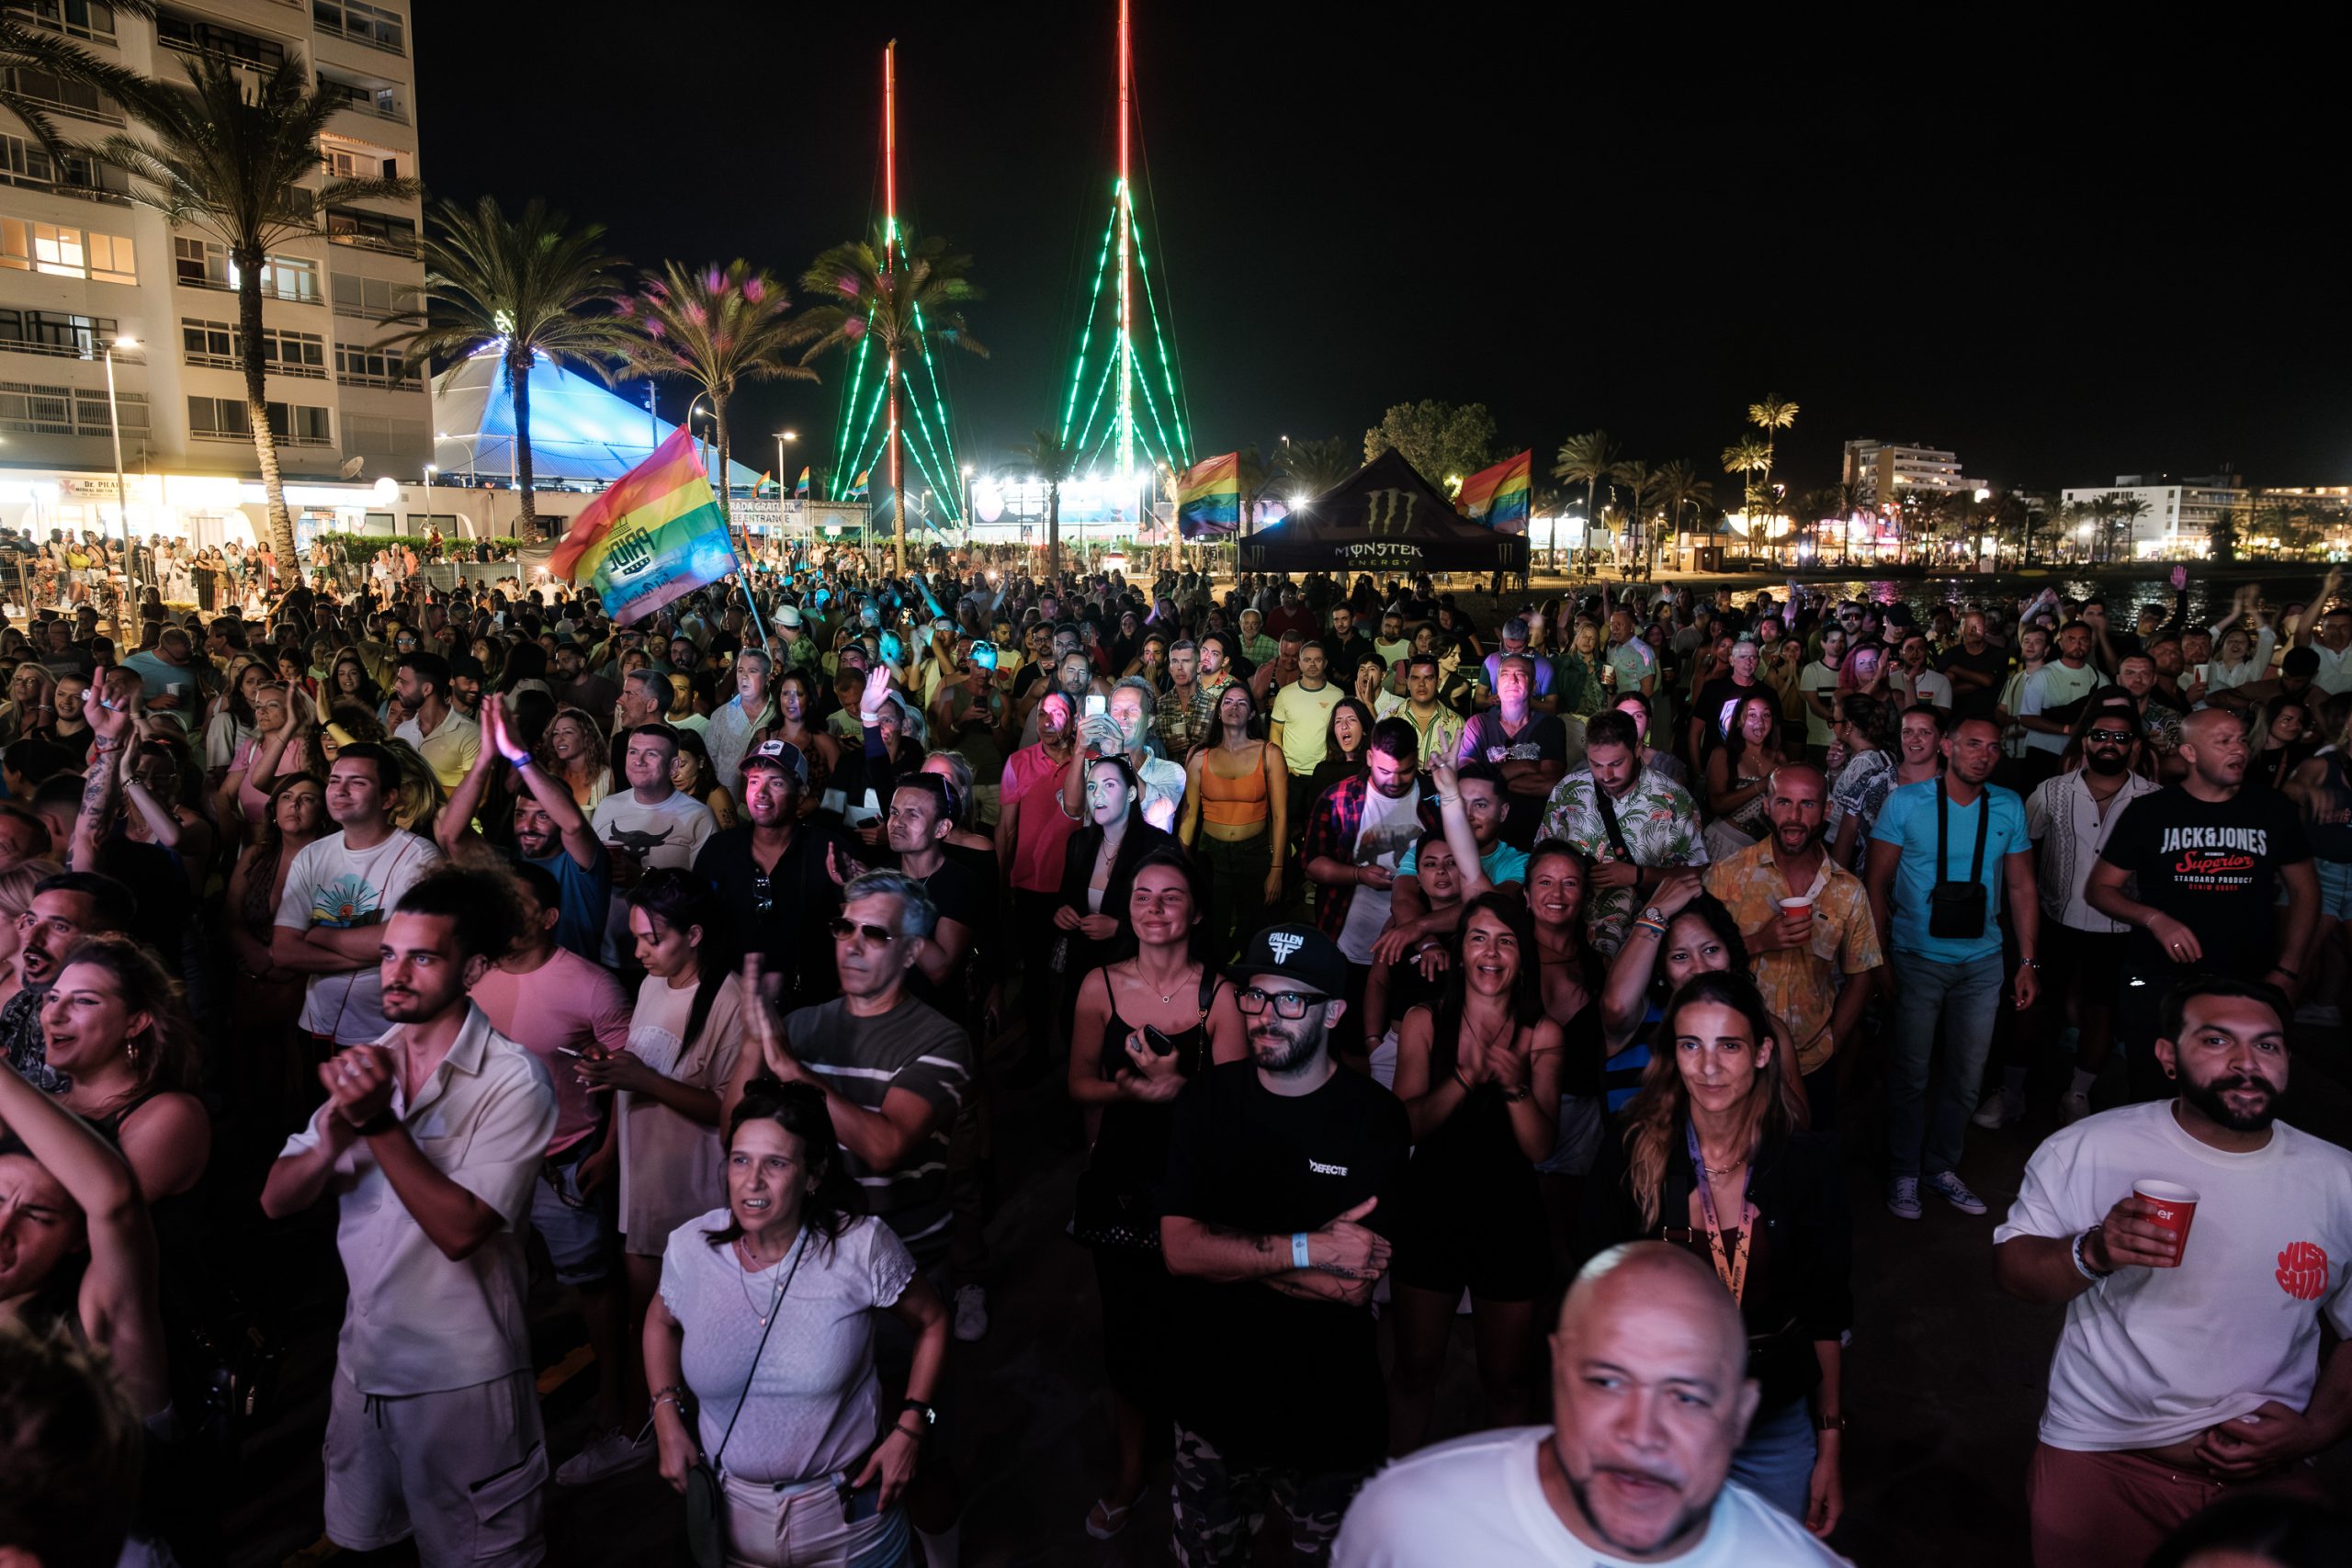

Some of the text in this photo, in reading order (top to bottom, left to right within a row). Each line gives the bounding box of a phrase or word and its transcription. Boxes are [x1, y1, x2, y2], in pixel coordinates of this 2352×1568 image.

[729, 502, 752, 512] RADA
[2160, 827, 2267, 856] JACK&JONES
[2175, 851, 2256, 874] Superior
[1268, 931, 1305, 946] FALLEN
[2156, 1209, 2174, 1221] er
[2278, 1241, 2327, 1272] JUST
